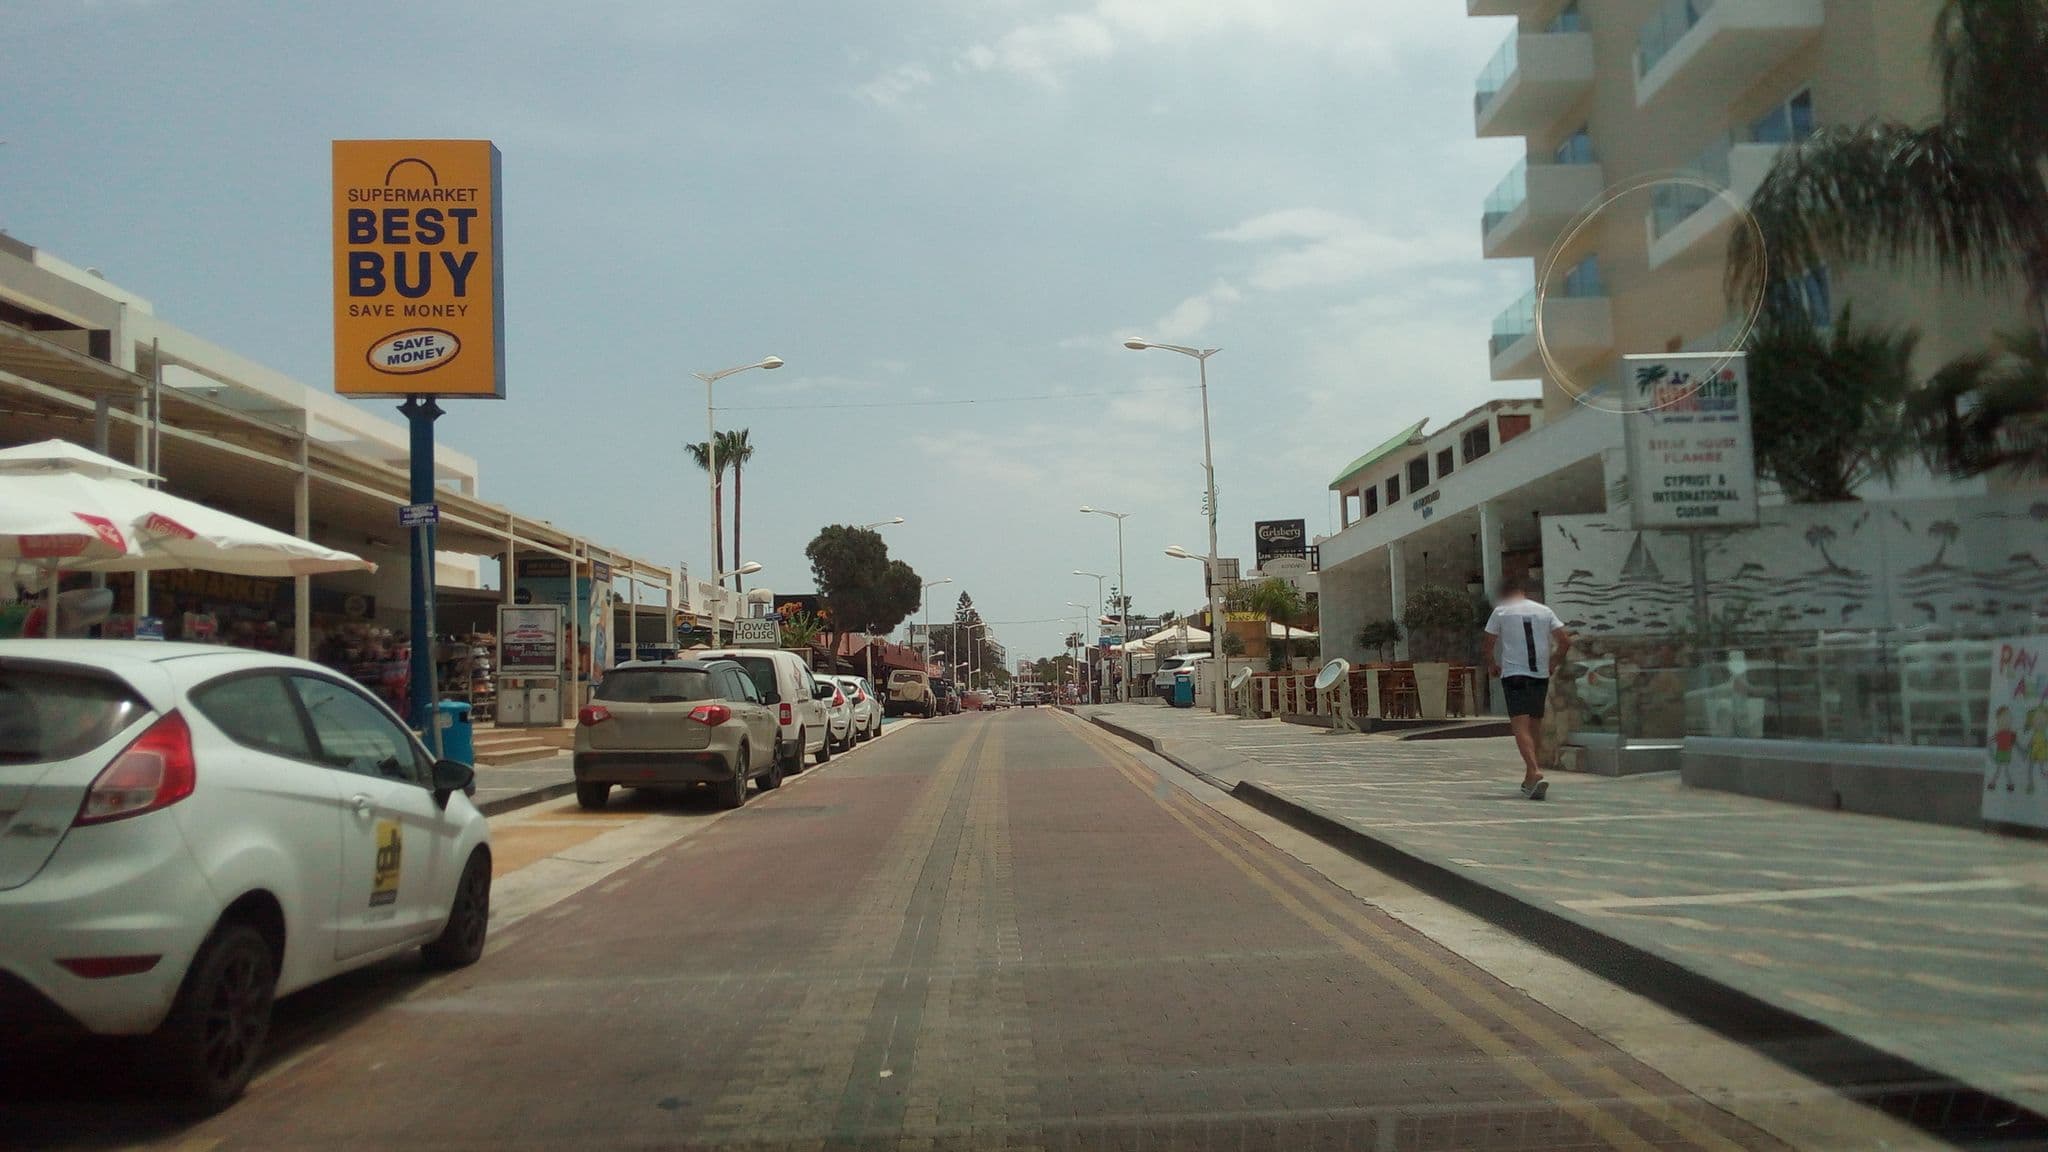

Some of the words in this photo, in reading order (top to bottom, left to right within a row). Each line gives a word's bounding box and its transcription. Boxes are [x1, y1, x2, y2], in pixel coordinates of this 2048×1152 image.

[348, 188, 478, 203] SUPERMARKET
[348, 208, 478, 245] BEST
[348, 251, 479, 298] BUY
[349, 304, 395, 317] SAVE
[404, 304, 469, 317] MONEY
[393, 335, 435, 351] SAVE
[387, 346, 446, 366] MONEY
[1664, 474, 1711, 487] CYPRIOT
[1653, 489, 1740, 503] INTERNATIONAL
[1676, 505, 1719, 518] CUISINE
[1258, 524, 1301, 541] Carlsberg
[736, 620, 774, 631] Tower
[735, 629, 775, 640] House
